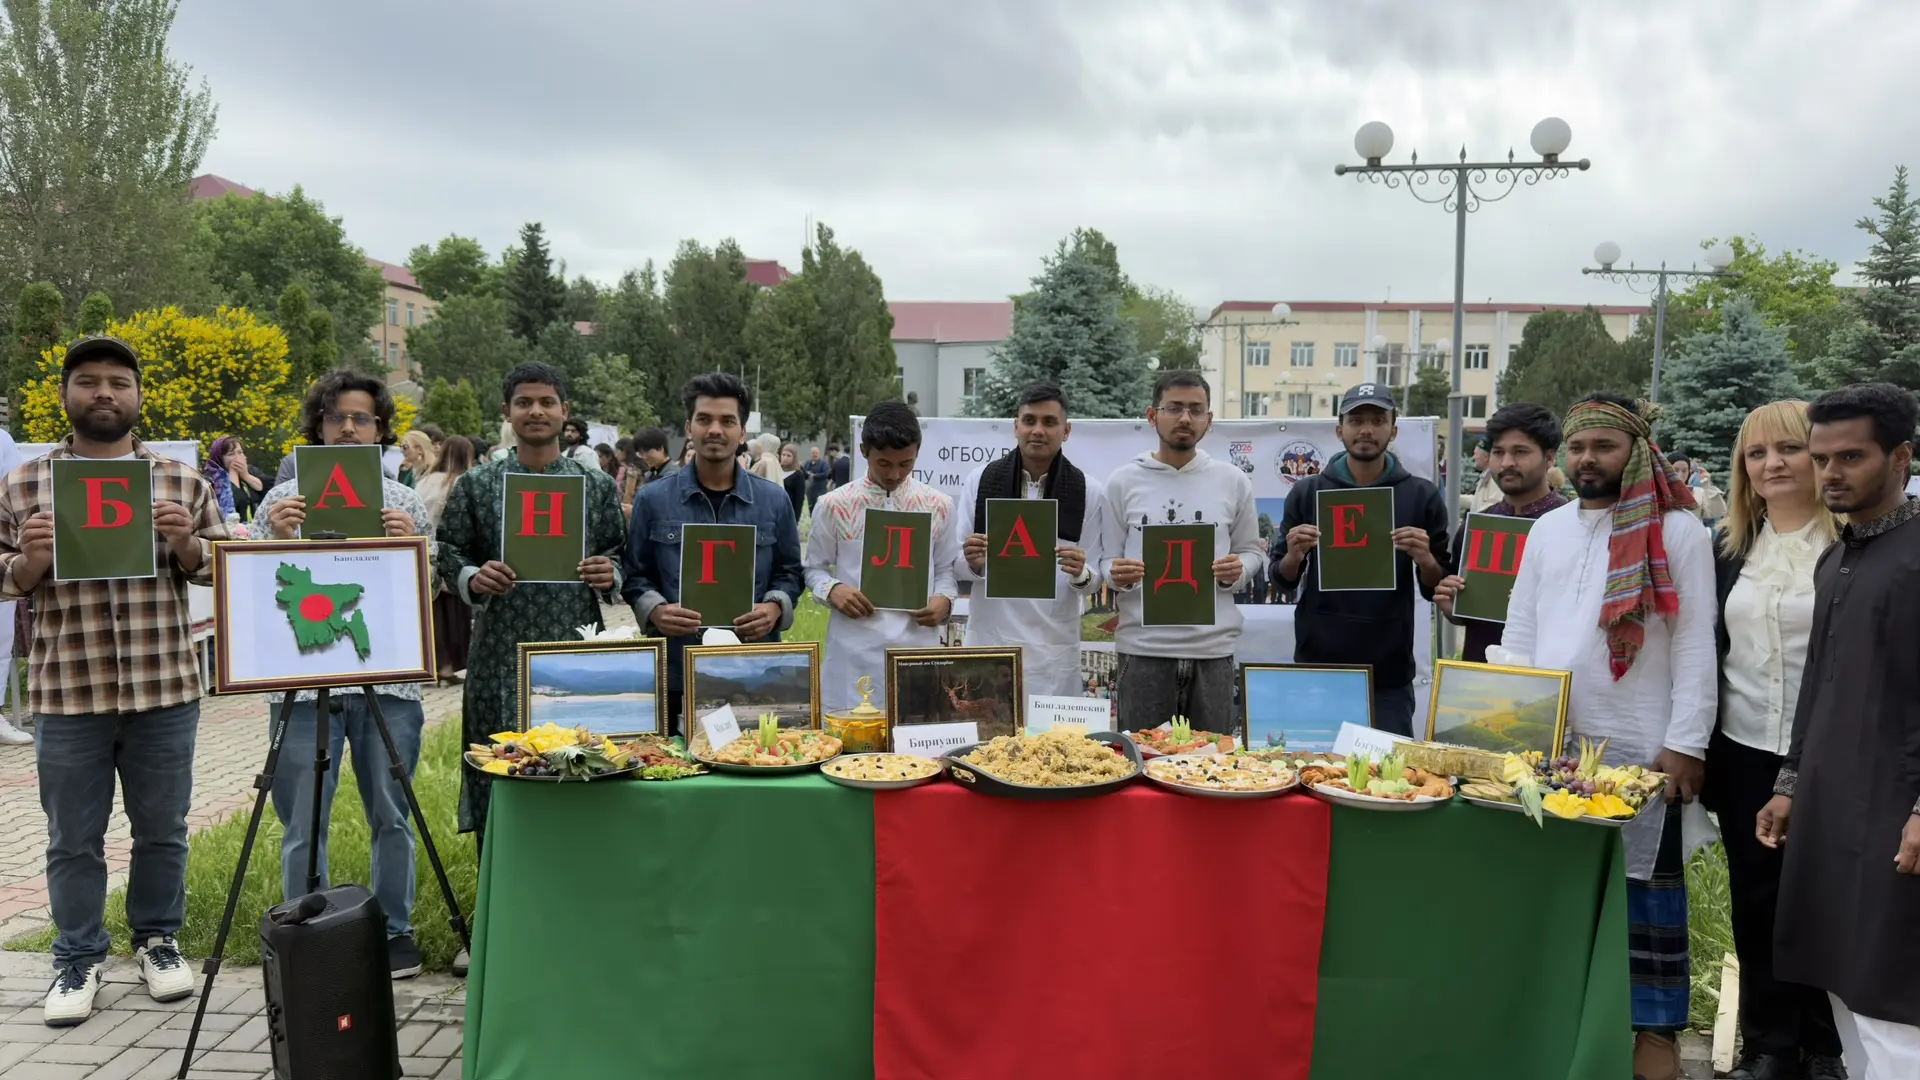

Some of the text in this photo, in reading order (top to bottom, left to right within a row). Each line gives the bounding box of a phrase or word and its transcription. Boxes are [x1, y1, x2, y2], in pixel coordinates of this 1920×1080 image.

[938, 446, 996, 462] ФГБОУ
[1230, 443, 1253, 452] 2026
[312, 462, 366, 510] А
[939, 474, 965, 486] им.
[77, 477, 135, 529] Б
[515, 491, 569, 537] Н
[870, 525, 917, 569] Л
[998, 514, 1041, 557] А
[1326, 504, 1369, 548] Е
[333, 554, 380, 562] Бангладеш
[695, 540, 736, 584] Г
[1153, 539, 1199, 596] Д
[1463, 528, 1528, 577] Ш
[1034, 700, 1106, 713] Бангладешский
